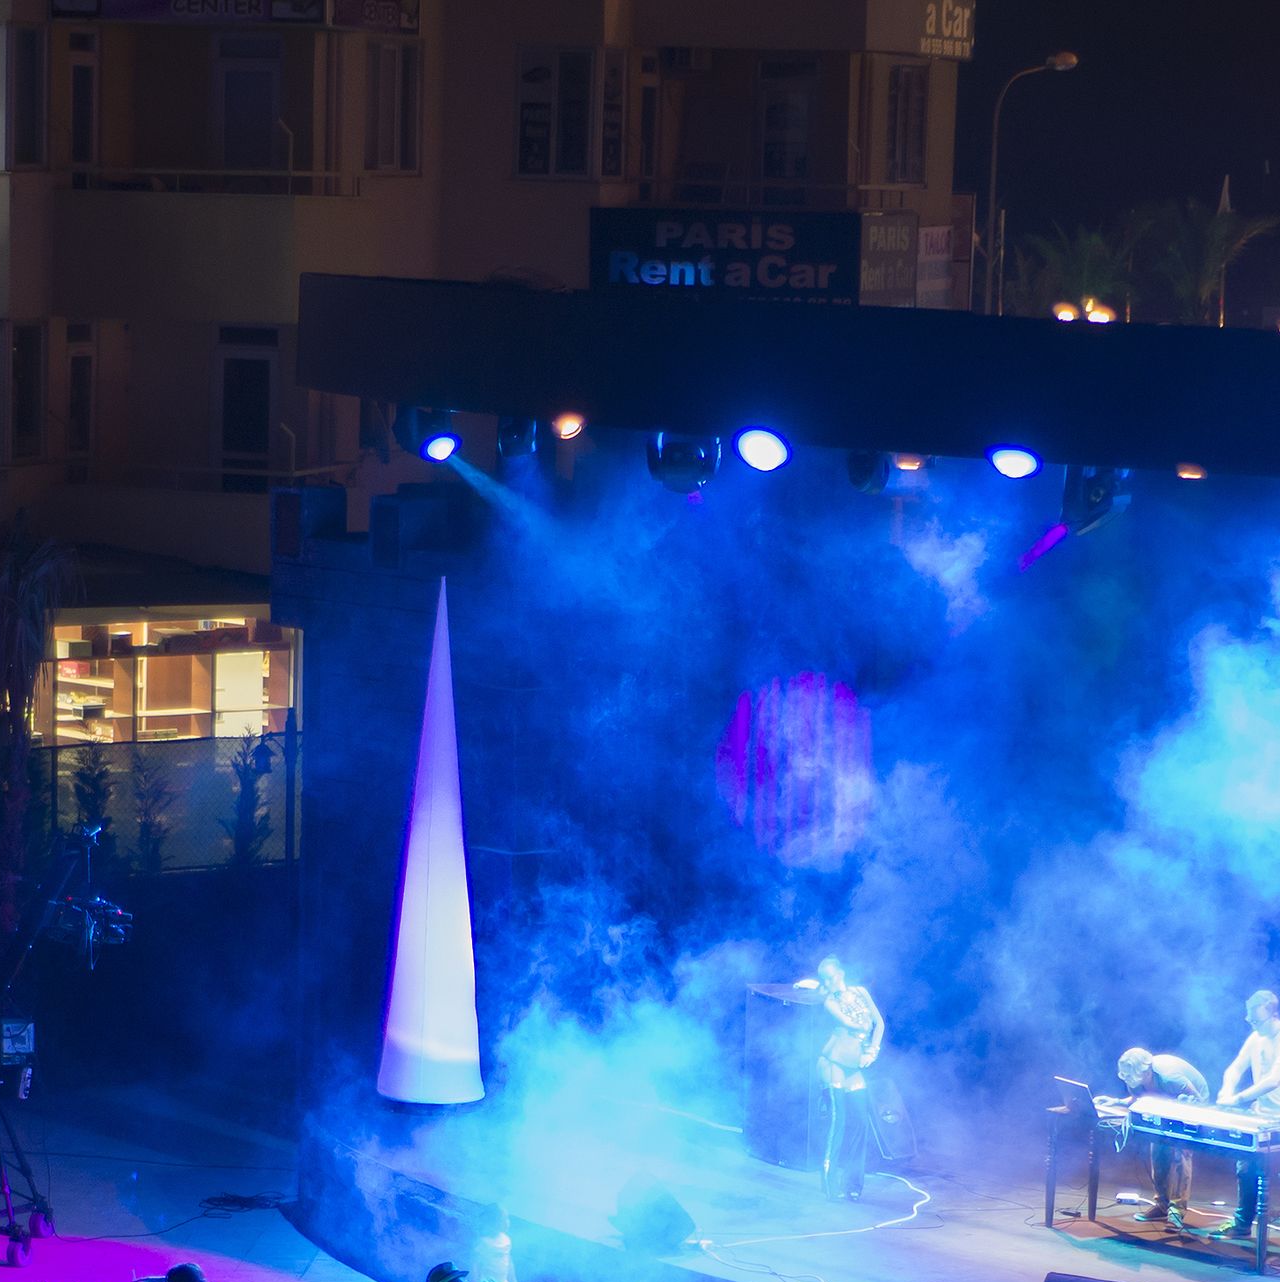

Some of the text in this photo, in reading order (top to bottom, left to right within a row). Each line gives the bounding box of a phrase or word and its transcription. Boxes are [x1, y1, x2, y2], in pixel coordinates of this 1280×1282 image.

[609, 251, 837, 289] Rent a Car
